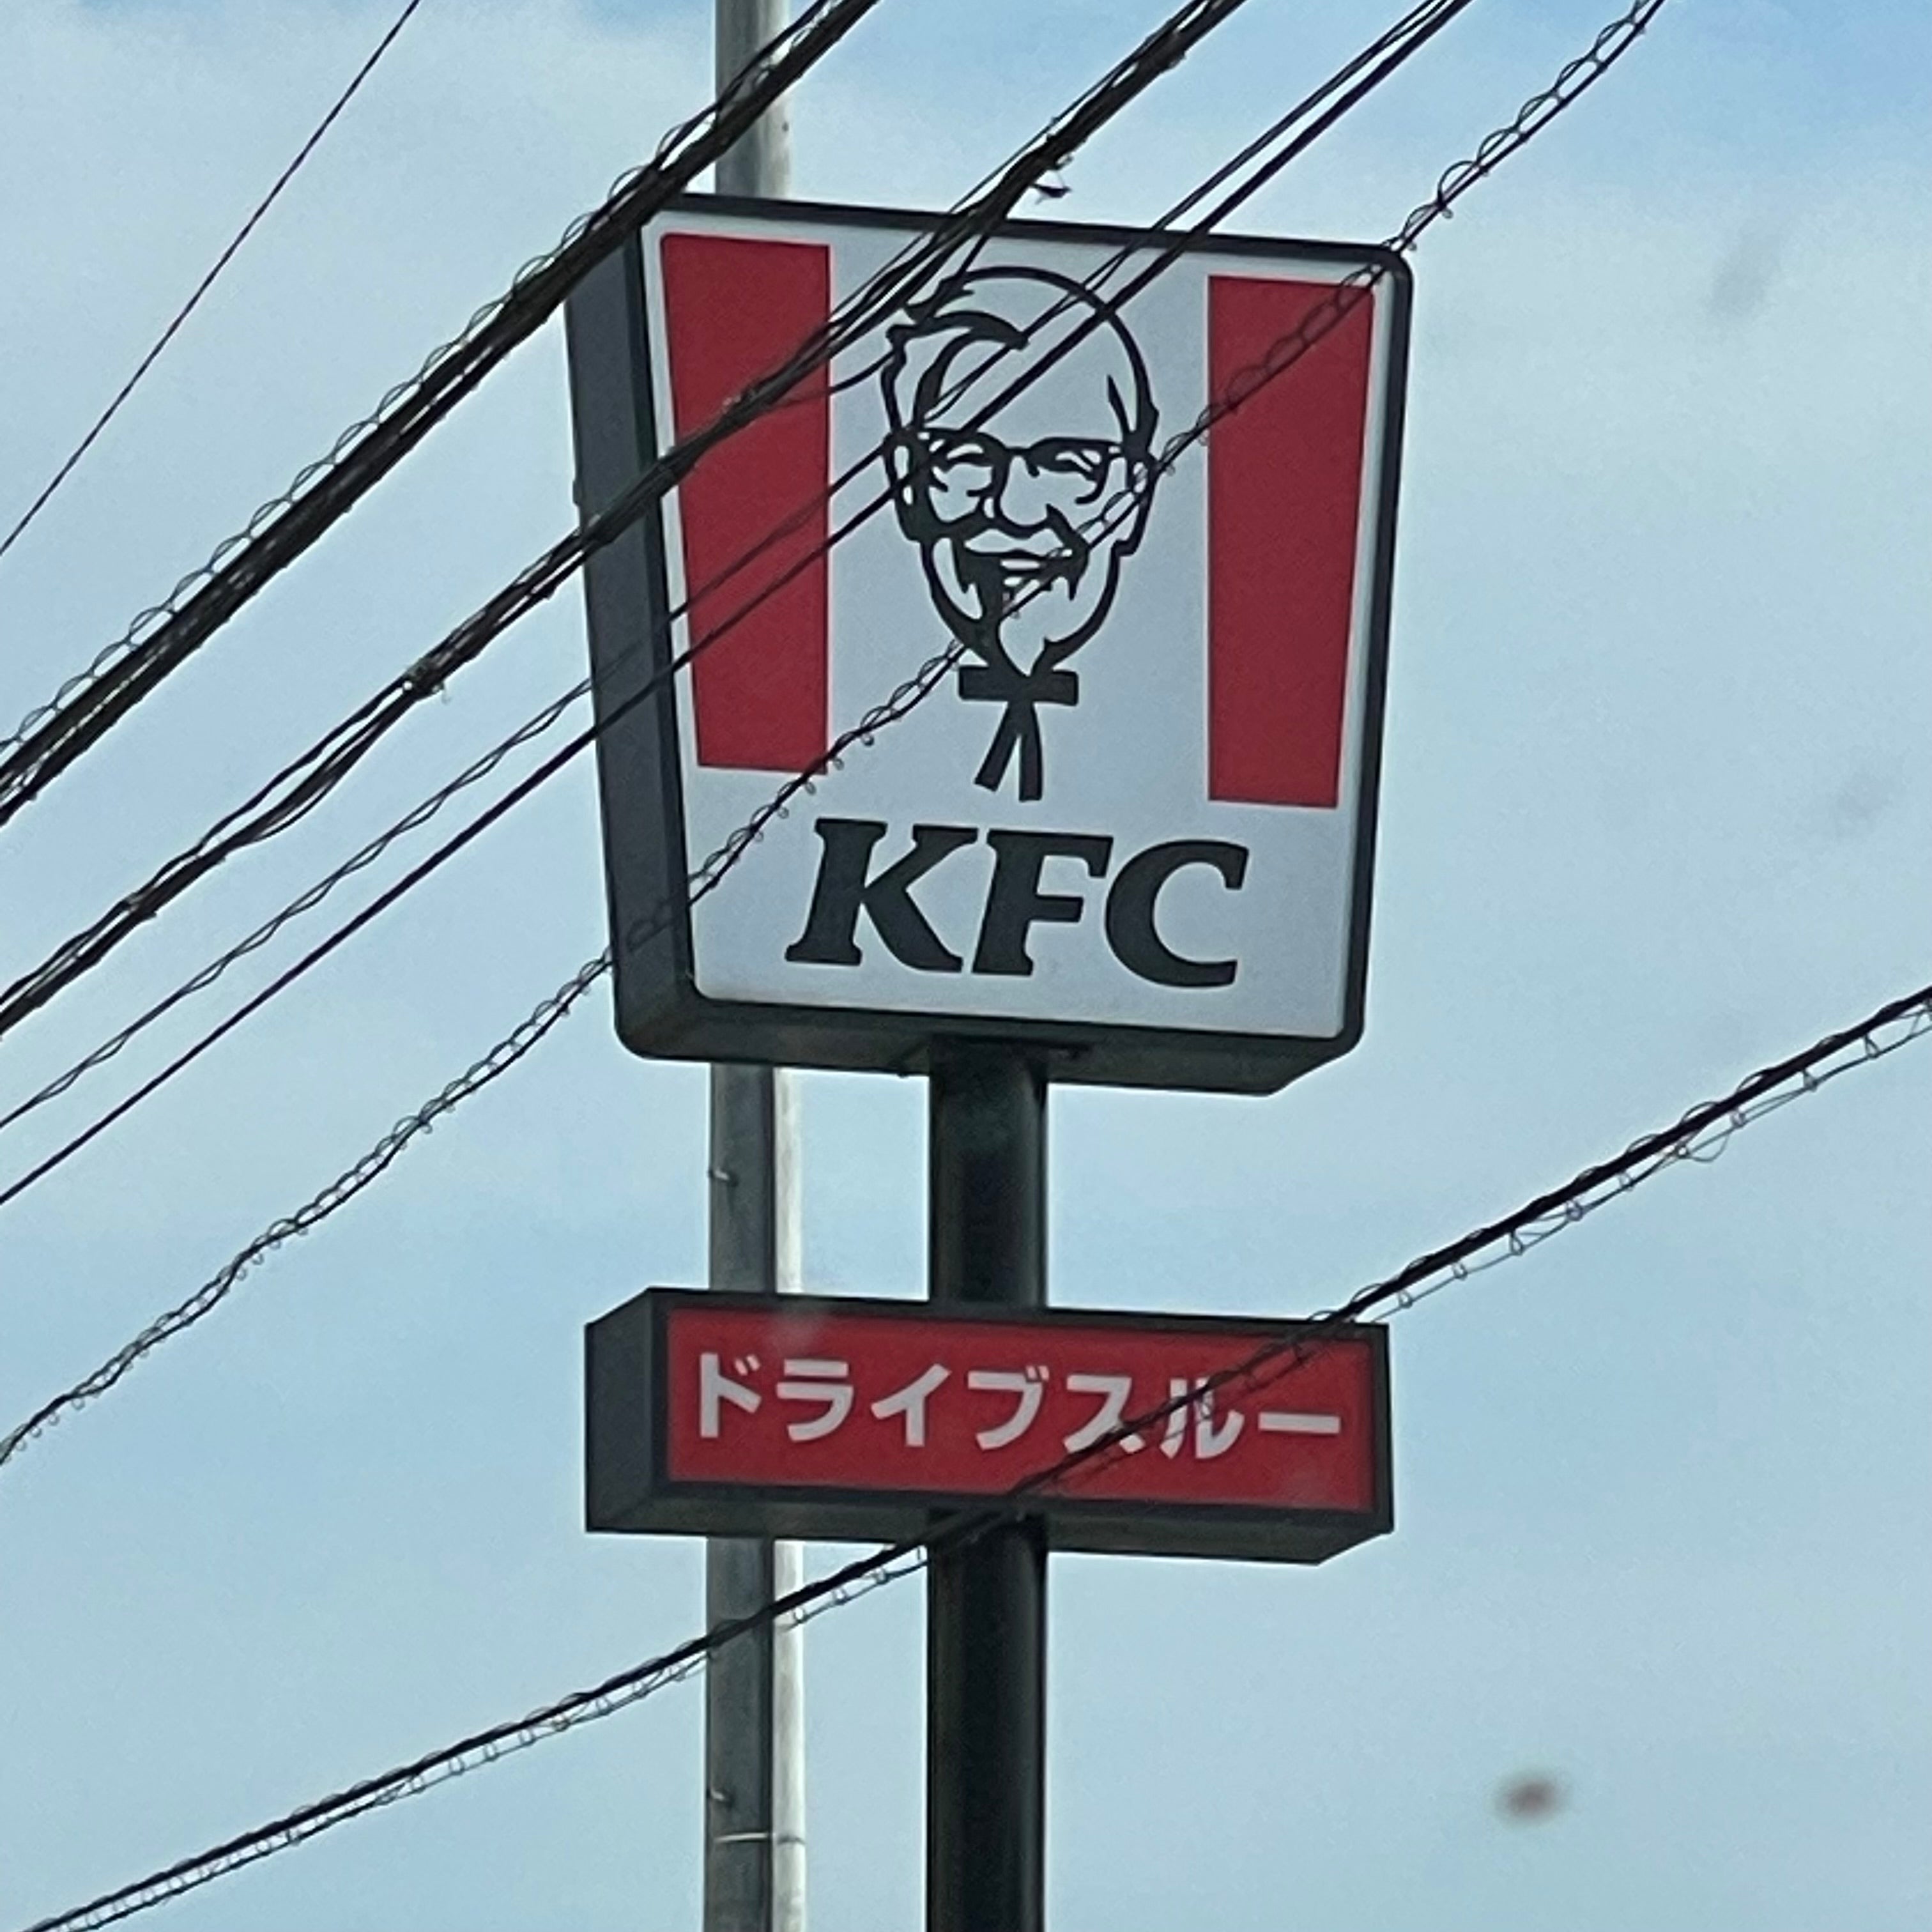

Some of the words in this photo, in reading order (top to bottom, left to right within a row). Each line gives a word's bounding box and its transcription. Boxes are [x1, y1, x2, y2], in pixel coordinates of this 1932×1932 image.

[786, 818, 1248, 986] KFC
[699, 1352, 1341, 1459] ドライブスルー
